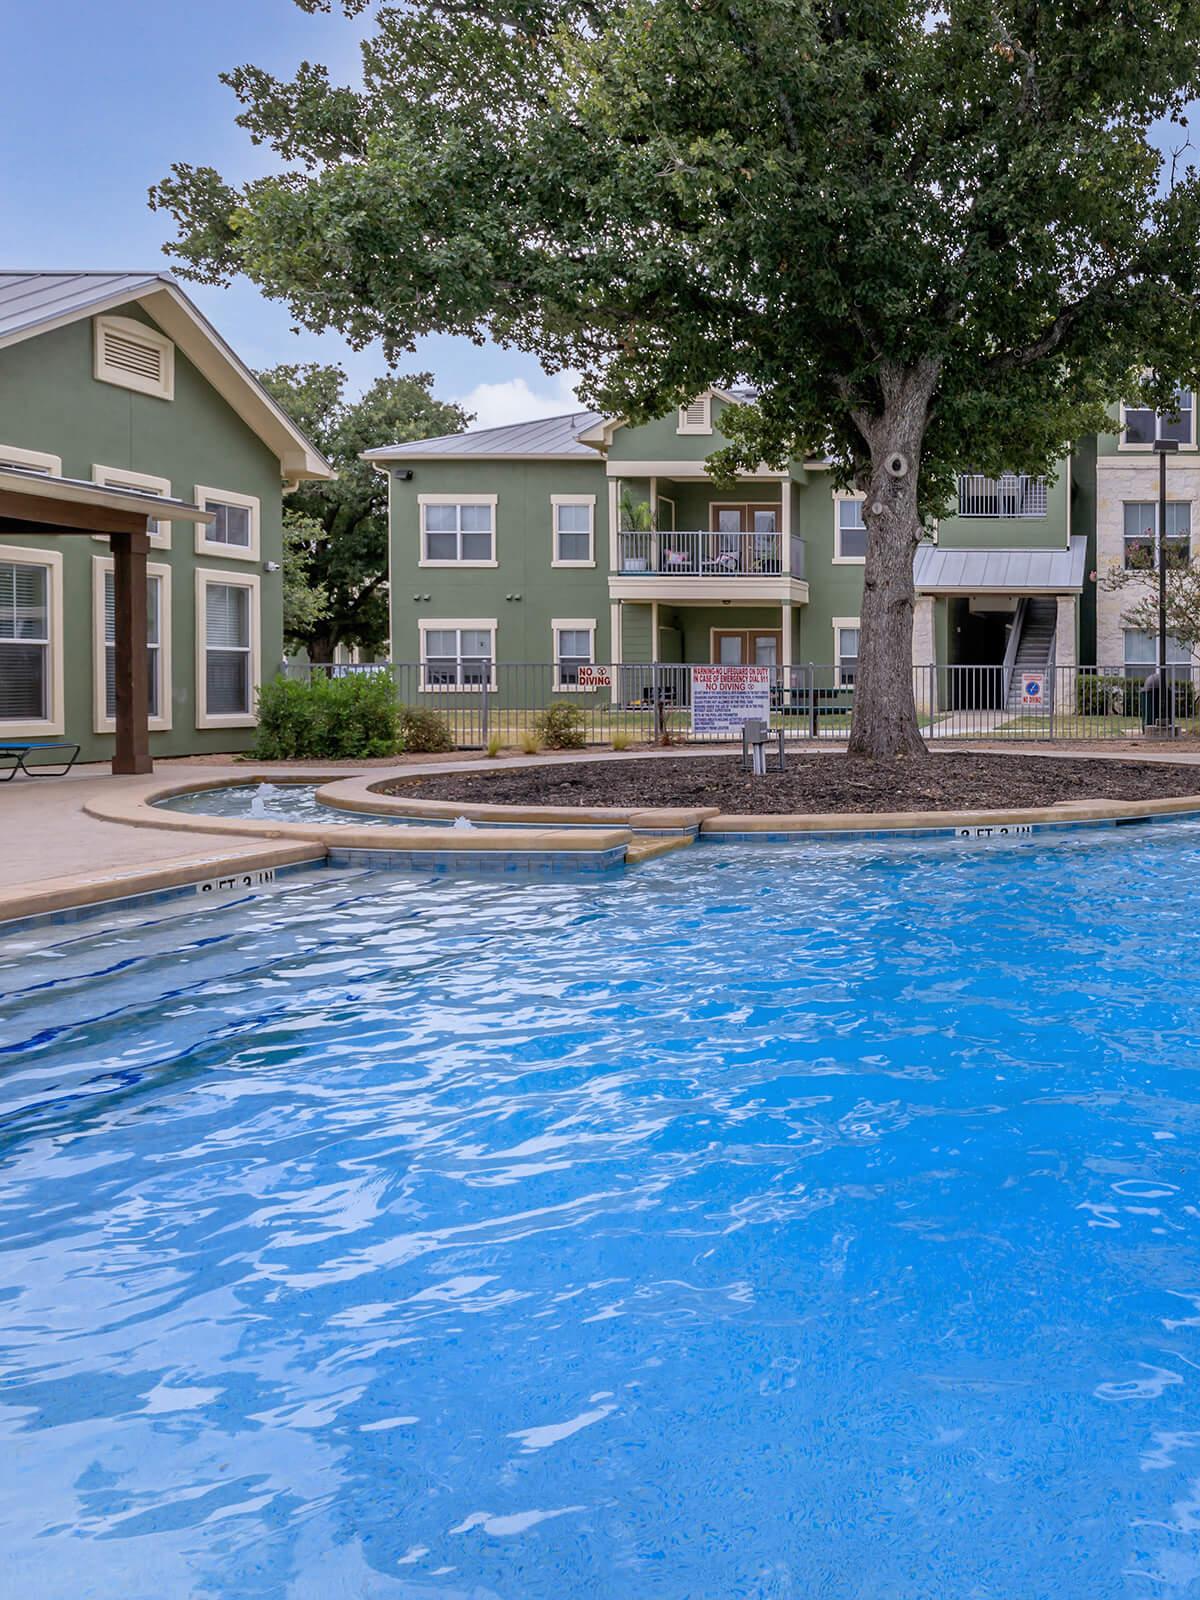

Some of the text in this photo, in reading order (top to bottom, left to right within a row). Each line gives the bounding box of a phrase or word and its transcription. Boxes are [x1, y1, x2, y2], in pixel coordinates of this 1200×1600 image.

[579, 667, 593, 676] NO
[579, 676, 611, 686] DIVING
[705, 683, 745, 691] NO DIVING
